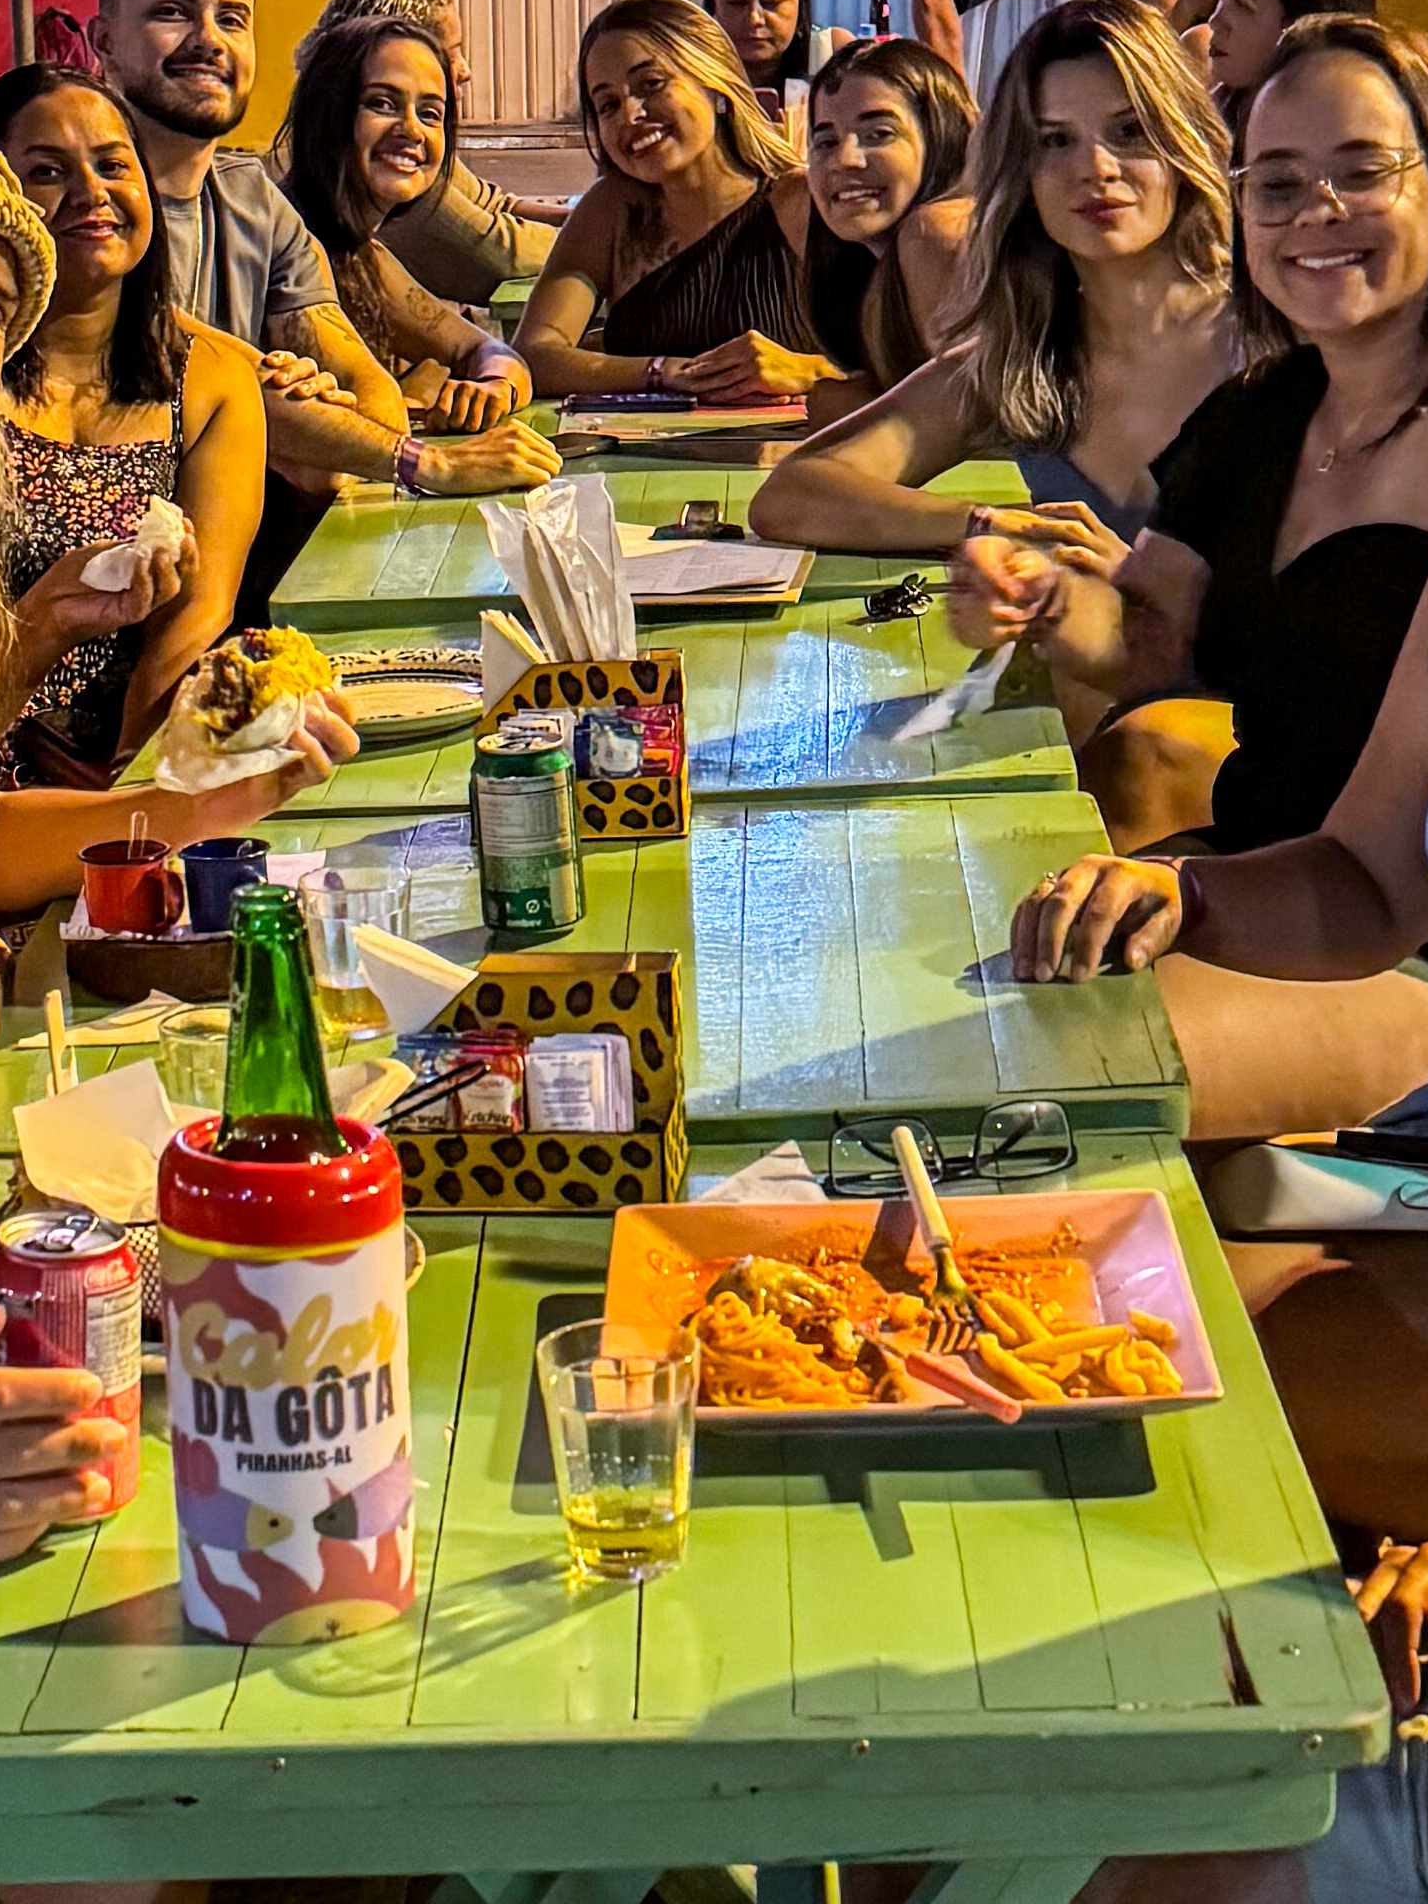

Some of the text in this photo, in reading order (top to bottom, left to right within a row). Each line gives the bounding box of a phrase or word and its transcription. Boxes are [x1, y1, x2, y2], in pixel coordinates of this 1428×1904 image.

[179, 1293, 400, 1393] Calor
[193, 1364, 396, 1448] DA GÔTA
[235, 1444, 353, 1473] PIRANHAS-AL
